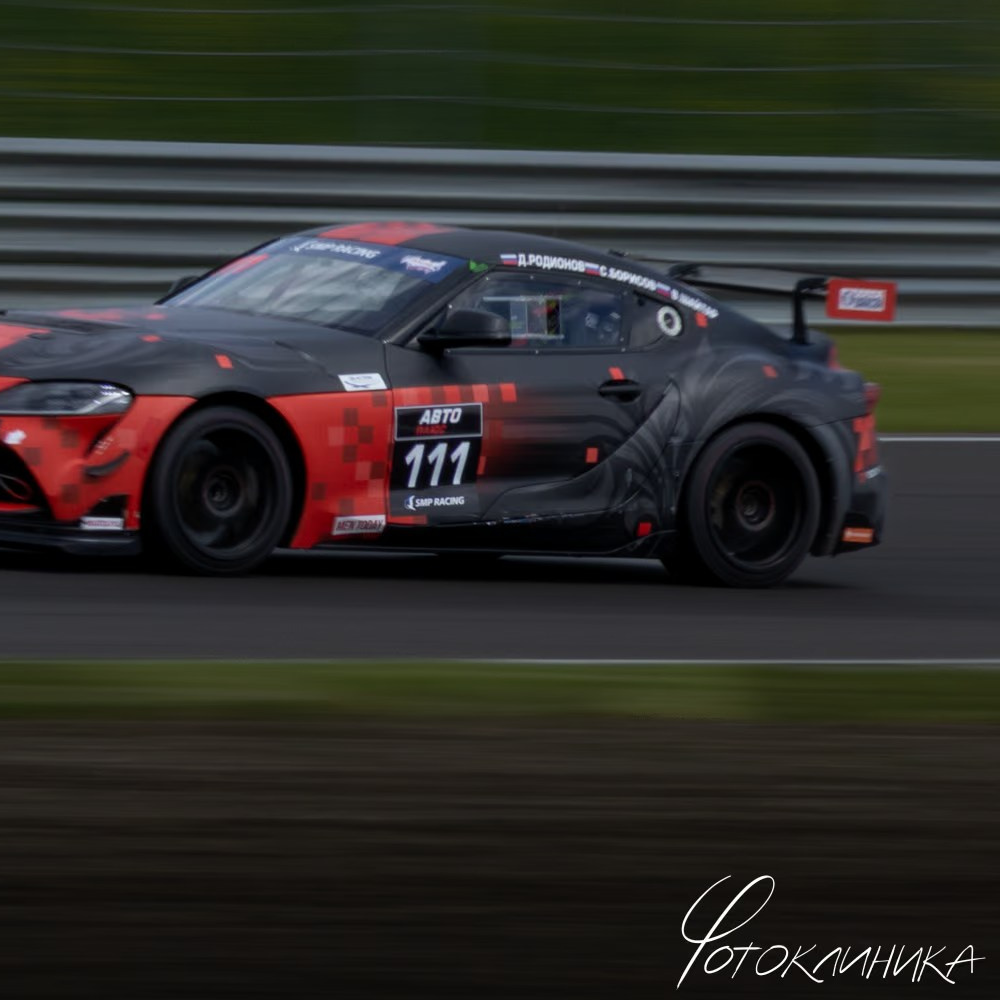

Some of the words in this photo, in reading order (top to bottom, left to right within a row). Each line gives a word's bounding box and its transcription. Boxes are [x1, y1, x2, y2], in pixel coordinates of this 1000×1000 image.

[518, 253, 585, 273] Д.РОДИОНОВ
[419, 407, 462, 425] АВТО
[405, 441, 471, 488] 111
[415, 497, 432, 507] SMP
[433, 496, 465, 506] RACING
